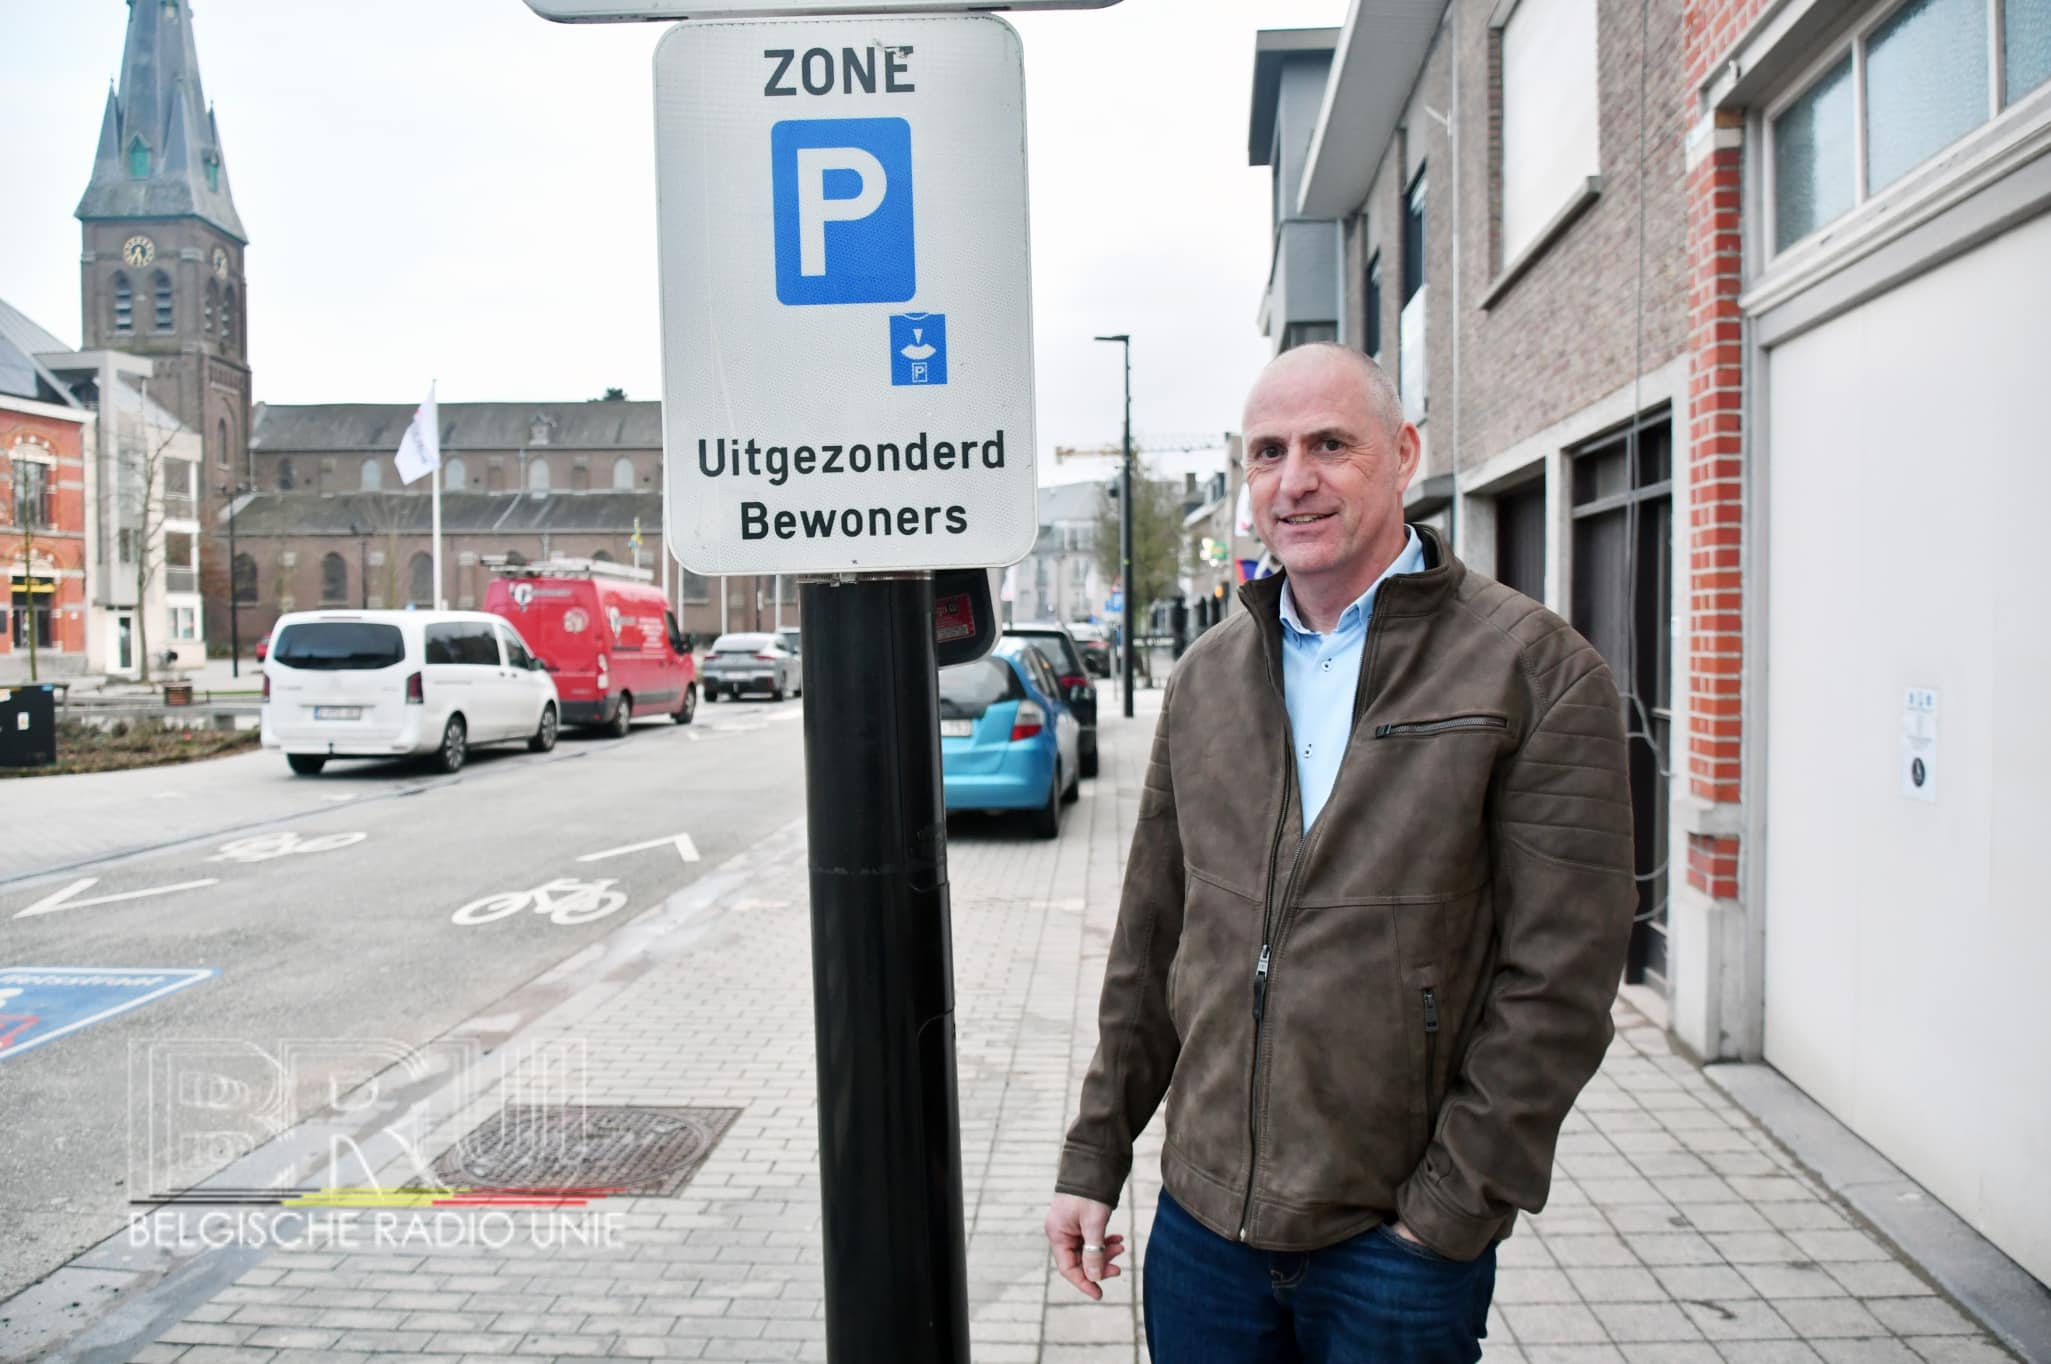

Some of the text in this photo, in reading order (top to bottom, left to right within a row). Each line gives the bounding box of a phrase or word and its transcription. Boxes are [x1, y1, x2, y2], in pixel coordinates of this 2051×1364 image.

[763, 45, 916, 96] ZONE
[796, 147, 888, 277] P
[698, 431, 1006, 486] Uitgezonderd
[740, 502, 968, 540] Bewoners
